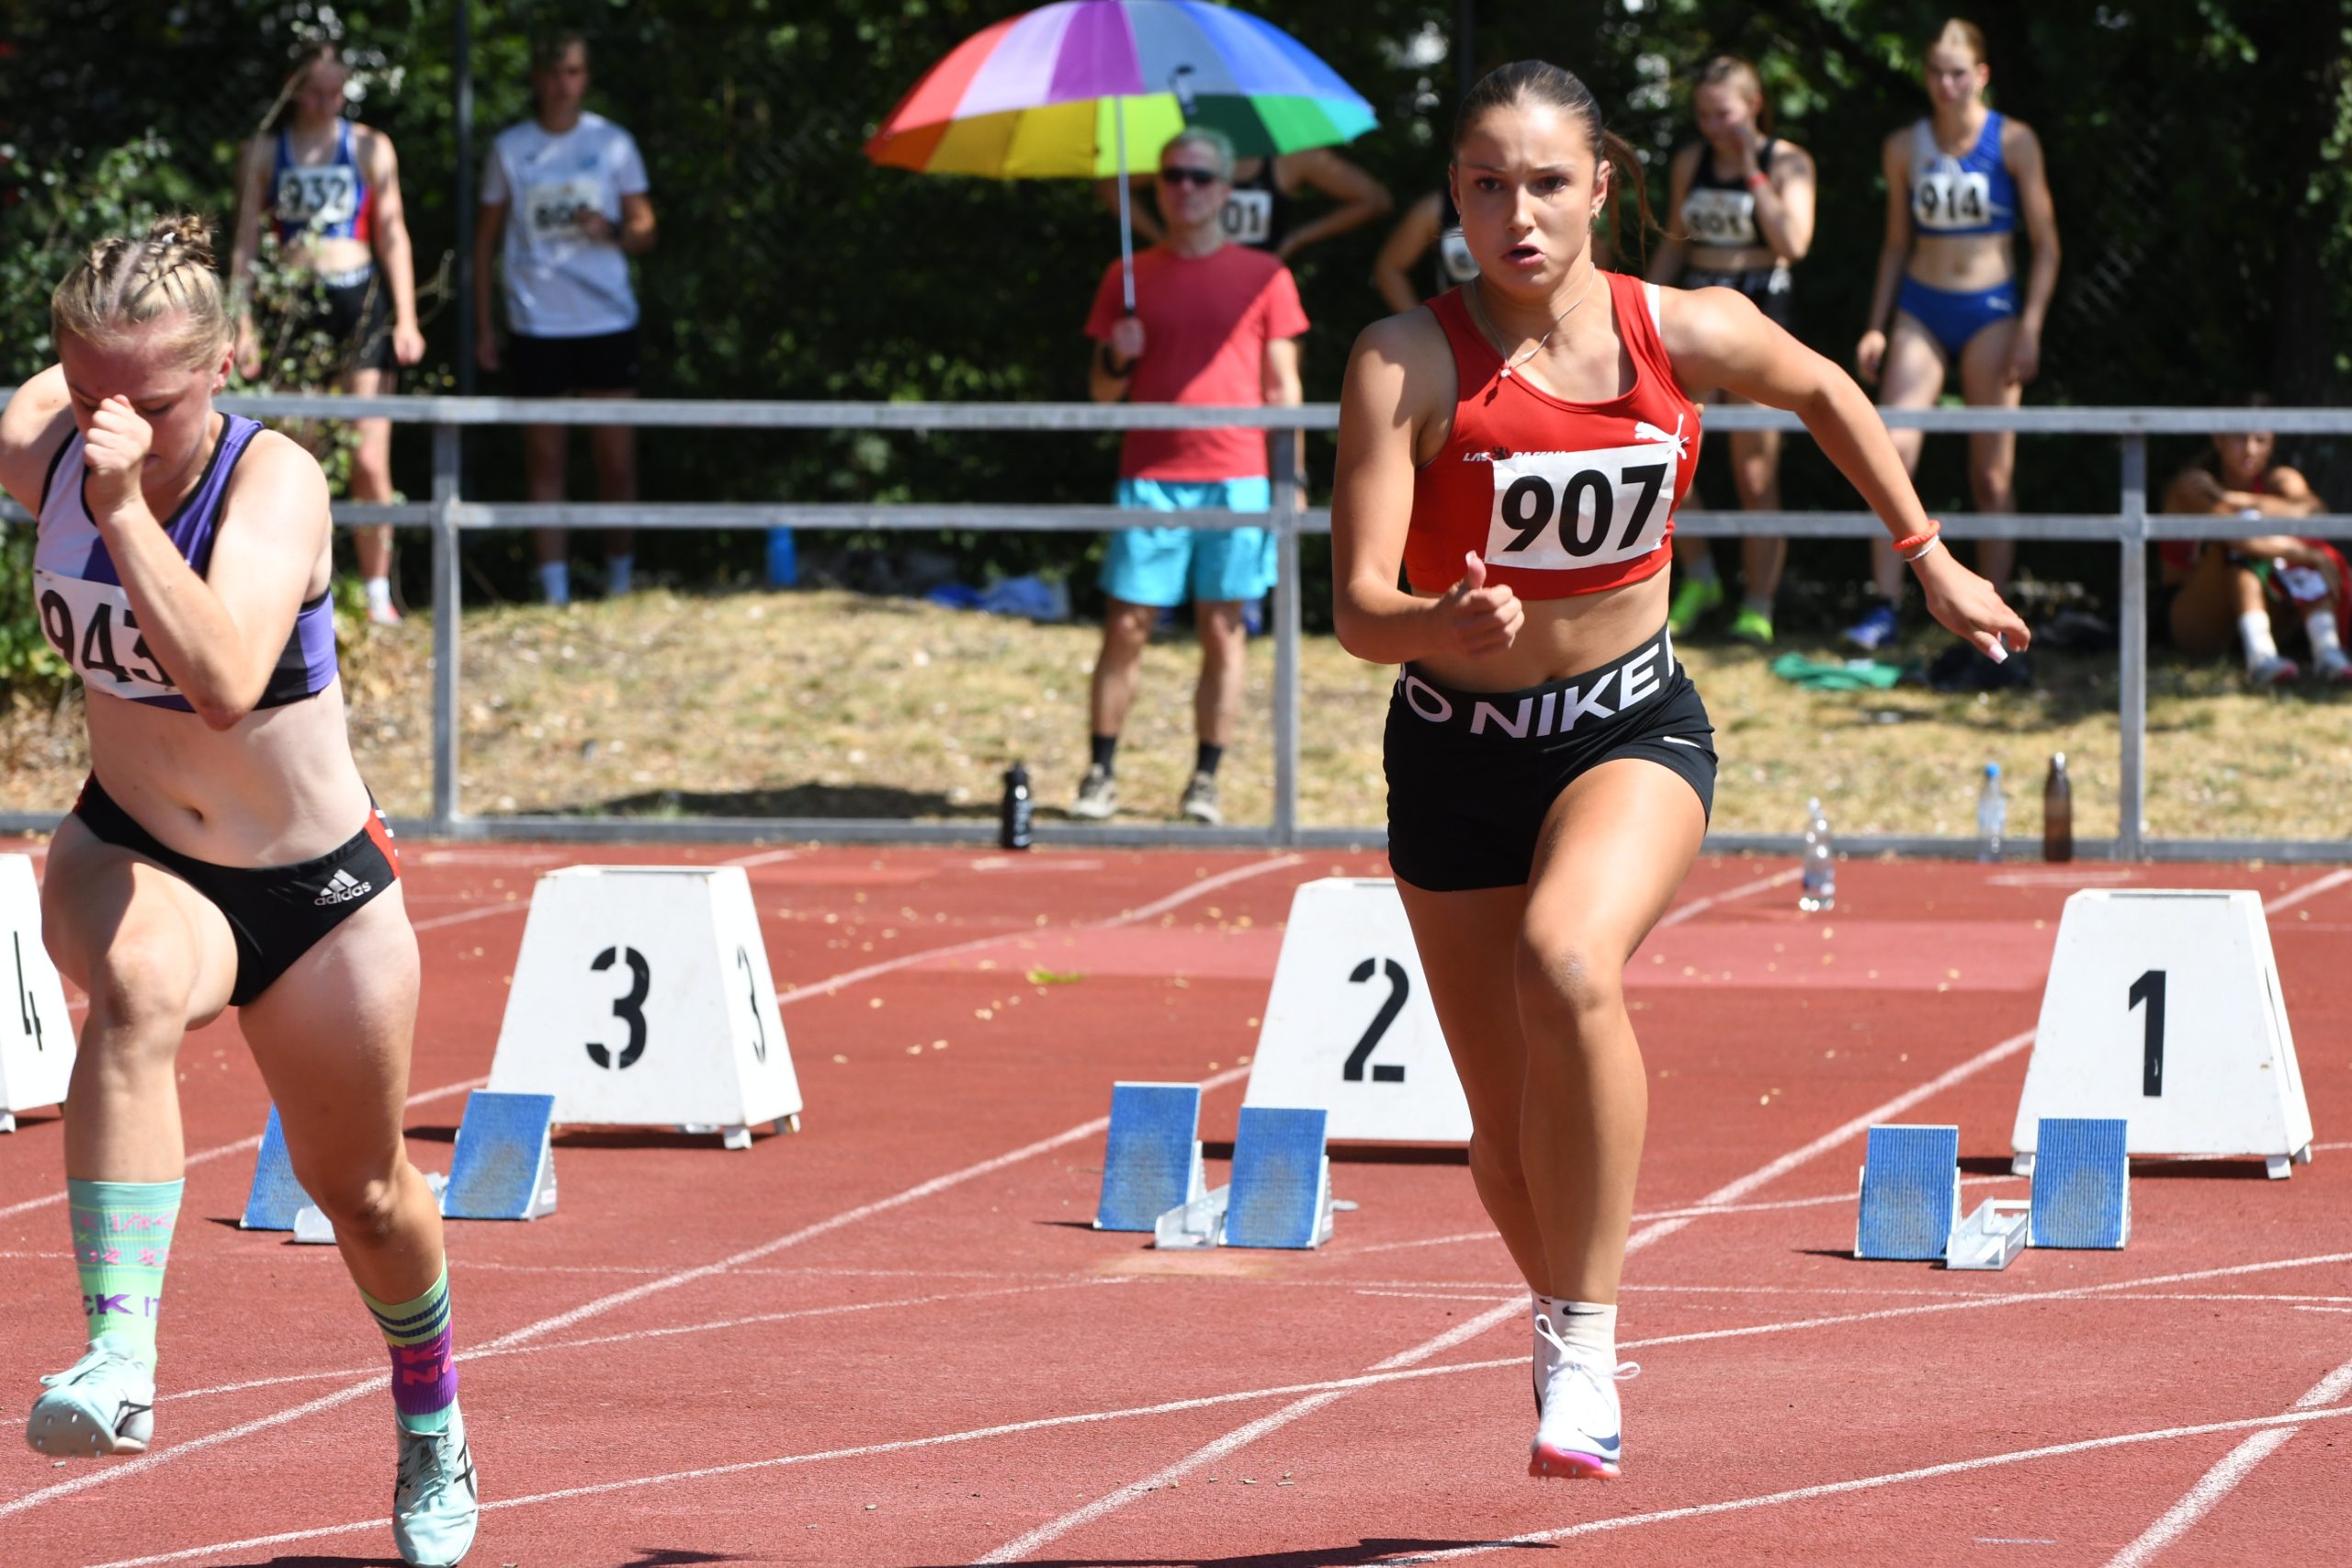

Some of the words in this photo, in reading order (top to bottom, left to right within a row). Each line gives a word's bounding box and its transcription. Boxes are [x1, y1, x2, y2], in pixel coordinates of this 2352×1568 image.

[286, 176, 348, 213] 932
[1218, 199, 1260, 235] 01
[1920, 183, 1981, 220] 914
[1501, 463, 1668, 558] 907
[1470, 643, 1659, 739] NIKE
[314, 881, 372, 906] adidas
[585, 945, 650, 1070] 3
[1342, 957, 1410, 1083] 2
[2129, 969, 2166, 1098] 1
